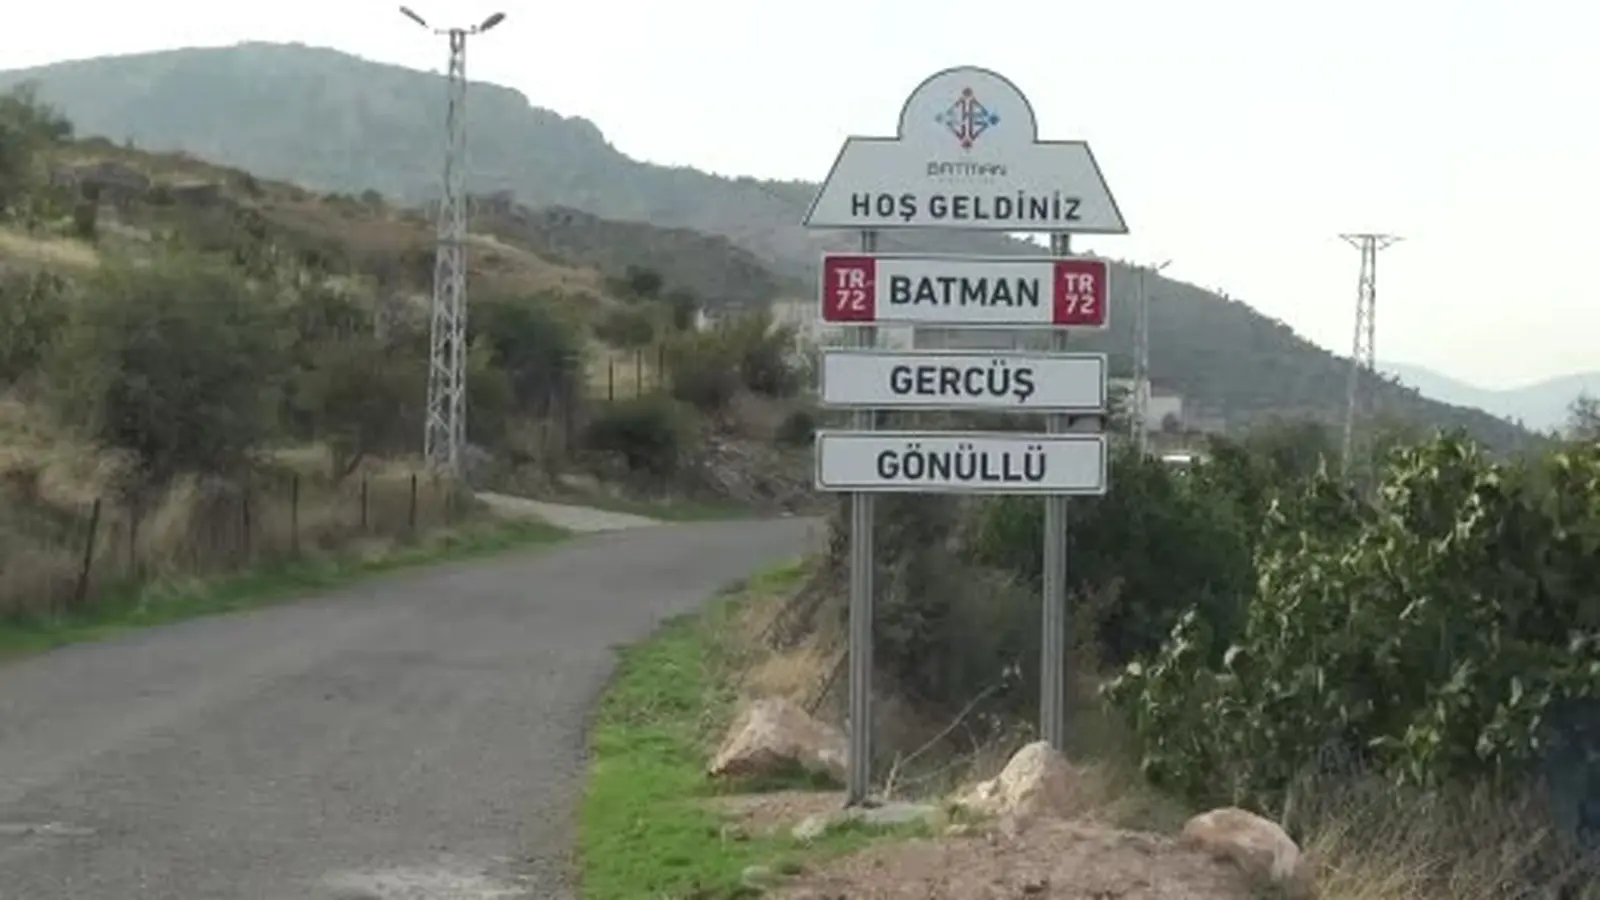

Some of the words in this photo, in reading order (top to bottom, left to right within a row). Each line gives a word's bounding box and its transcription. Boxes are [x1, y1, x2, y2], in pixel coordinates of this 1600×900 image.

[851, 193, 917, 221] HOŞ
[929, 190, 1081, 221] GELDİNİZ
[834, 268, 865, 288] TR
[1065, 273, 1094, 293] TR
[836, 291, 865, 310] 72
[890, 275, 1039, 307] BATMAN
[1066, 296, 1094, 315] 72
[891, 359, 1035, 402] GERCÜŞ
[877, 442, 1046, 482] GÖNÜLLÜ
